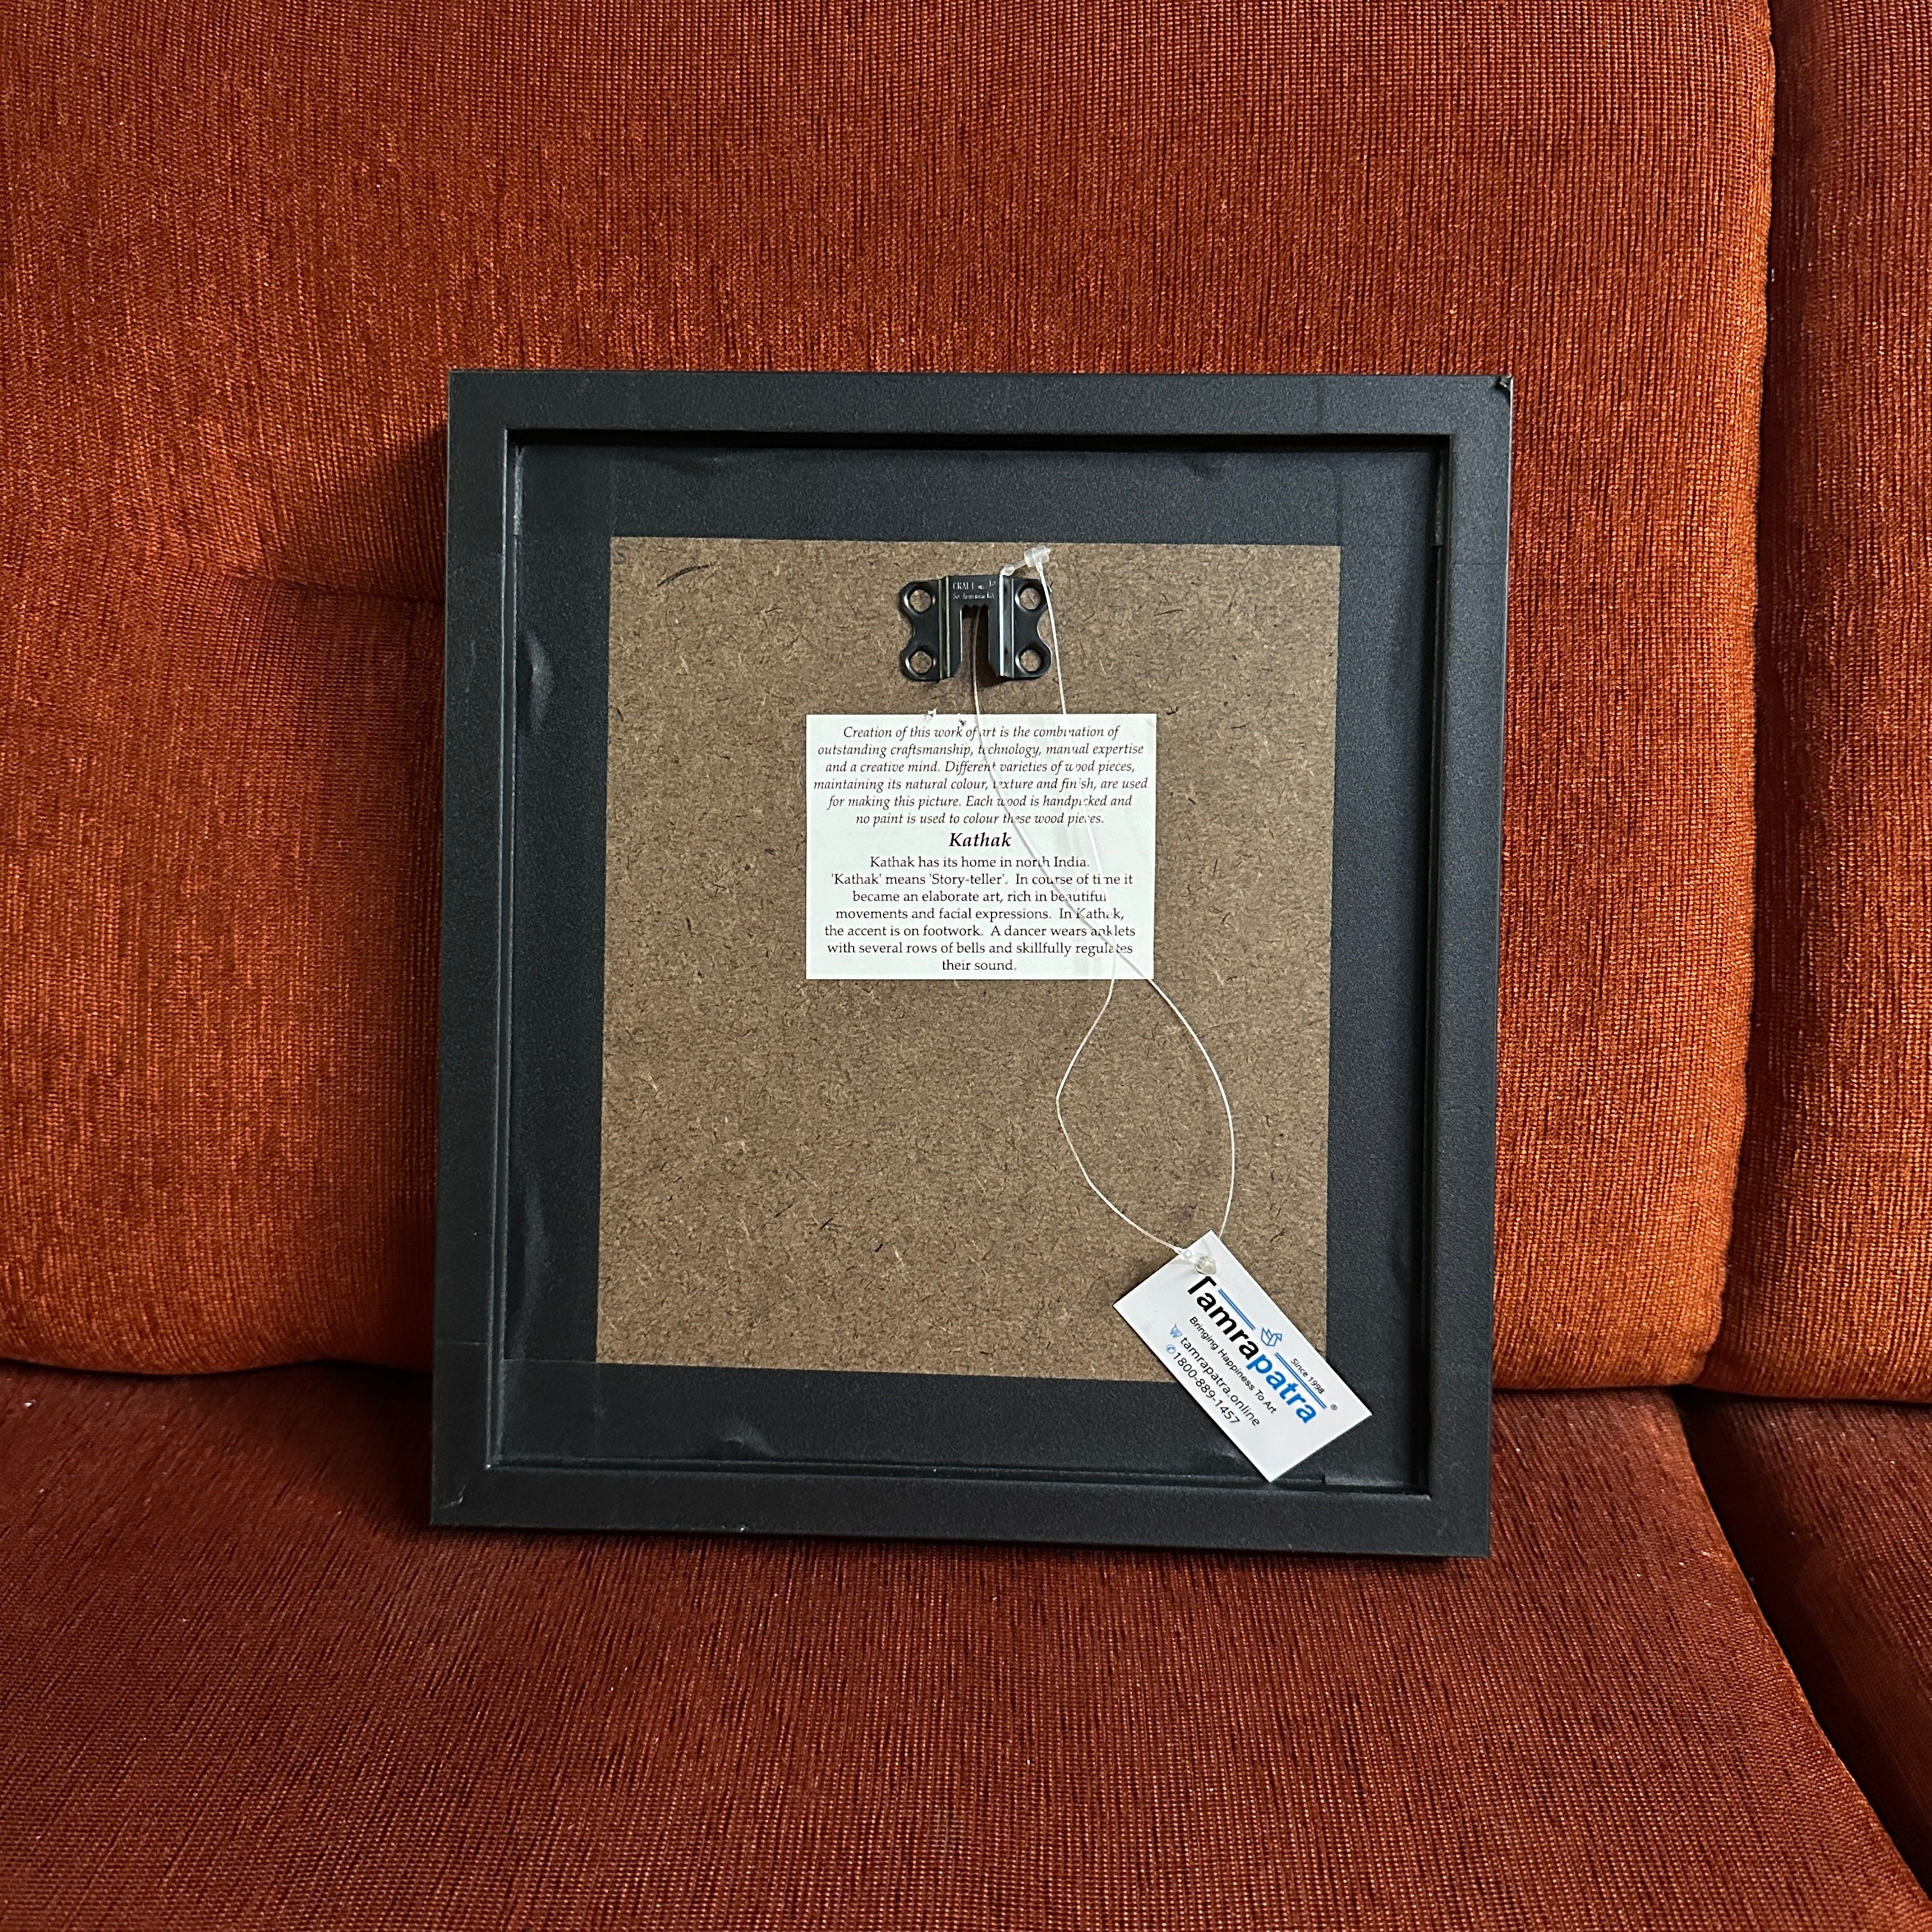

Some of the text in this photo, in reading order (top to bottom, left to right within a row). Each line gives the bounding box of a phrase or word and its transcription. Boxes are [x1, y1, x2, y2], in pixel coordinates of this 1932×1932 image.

[843, 726, 893, 738] Creation
[895, 726, 908, 742] of
[910, 726, 931, 738] this
[934, 726, 963, 737] work
[965, 725, 978, 741] of
[1000, 726, 1009, 737] is
[1013, 726, 1031, 737] the
[1033, 726, 1104, 737] combination
[1107, 725, 1121, 740] of
[818, 743, 887, 759] outstanding
[890, 743, 974, 759] craftsmanship,
[1046, 742, 1089, 755] manual
[1092, 743, 1144, 758] expertise
[825, 760, 847, 772] and
[850, 764, 857, 772] a
[860, 760, 905, 772] creative
[907, 760, 941, 772] mind.
[944, 760, 997, 776] Different
[999, 760, 1048, 772] varieties
[1050, 760, 1064, 776] of
[1098, 760, 1135, 775] pieces,
[813, 778, 885, 793] maintaining
[887, 778, 902, 790] its
[905, 778, 947, 790] natural
[950, 778, 988, 791] colour,
[1036, 778, 1059, 789] and
[1100, 781, 1119, 789] are
[1122, 777, 1148, 789] used
[826, 795, 845, 811] for
[848, 795, 891, 811] making
[894, 795, 915, 807] this
[917, 795, 961, 810] picture.
[965, 795, 993, 807] Each
[997, 795, 1027, 807] wood
[1030, 795, 1039, 807] is
[1110, 795, 1133, 806] and
[856, 816, 870, 824] no
[873, 812, 903, 827] paint
[907, 812, 916, 824] is
[919, 812, 946, 824] used
[949, 813, 960, 824] to
[963, 812, 1000, 824] colour
[1002, 812, 1031, 824] these
[1034, 812, 1065, 824] wood
[948, 832, 1012, 847] Kathak
[870, 855, 1090, 868] Kathak has its home in north India.
[831, 873, 1133, 889] 'Kathak' means 'Story-teller'. In course of time it
[852, 890, 900, 902] became
[922, 890, 979, 902] elaborate
[983, 891, 1004, 904] art,
[1007, 890, 1032, 902] rich
[1035, 890, 1048, 902] in
[1050, 890, 1107, 902] beautiful
[835, 908, 908, 919] movements
[911, 907, 935, 919] and
[939, 907, 972, 919] facial
[975, 907, 1052, 923] expressions.
[1059, 907, 1073, 919] In
[825, 924, 1136, 937] the accent is on footwork. A dancer wears anklets
[827, 942, 1133, 958] with several rows of bells and skillfully regulates
[942, 959, 1017, 970] their sound.
[1187, 1275, 1317, 1424] Tamrapatra
[1189, 1316, 1277, 1414] Bringing Happiness To Art
[1180, 1337, 1260, 1427] tamrapatra.online
[1290, 1358, 1325, 1394] Since 1998
[1173, 1352, 1241, 1423] 1800-889-1457
